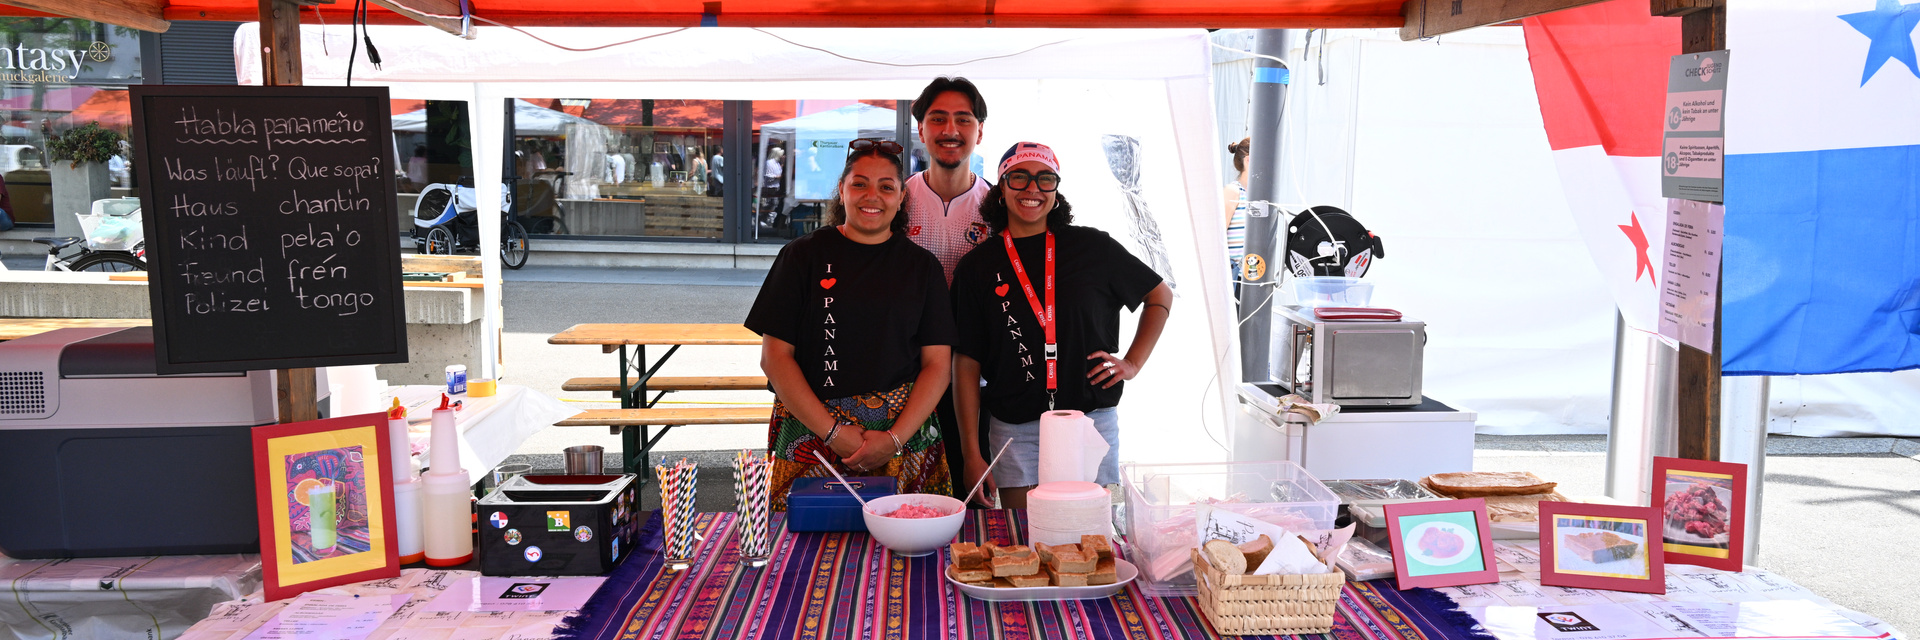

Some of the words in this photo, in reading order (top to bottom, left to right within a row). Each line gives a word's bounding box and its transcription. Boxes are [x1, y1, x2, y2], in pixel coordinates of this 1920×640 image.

[1685, 66, 1707, 77] CHECK
[174, 105, 257, 136] Habla
[263, 111, 364, 151] panameño
[1017, 152, 1054, 165] PANAMA
[164, 156, 208, 181] Was
[214, 154, 280, 193] läuft?
[288, 156, 329, 181] Que
[334, 156, 381, 194] sopa?
[170, 192, 239, 218] Haus
[279, 188, 370, 215] chantin
[180, 224, 249, 251] Kind
[287, 252, 347, 293] frén
[826, 263, 832, 273] I
[185, 286, 271, 315] Polizei
[295, 286, 374, 317] tongo
[823, 296, 839, 388] PANAMA
[996, 272, 1003, 283] I
[1001, 300, 1035, 382] PANAMA
[554, 518, 564, 527] B
